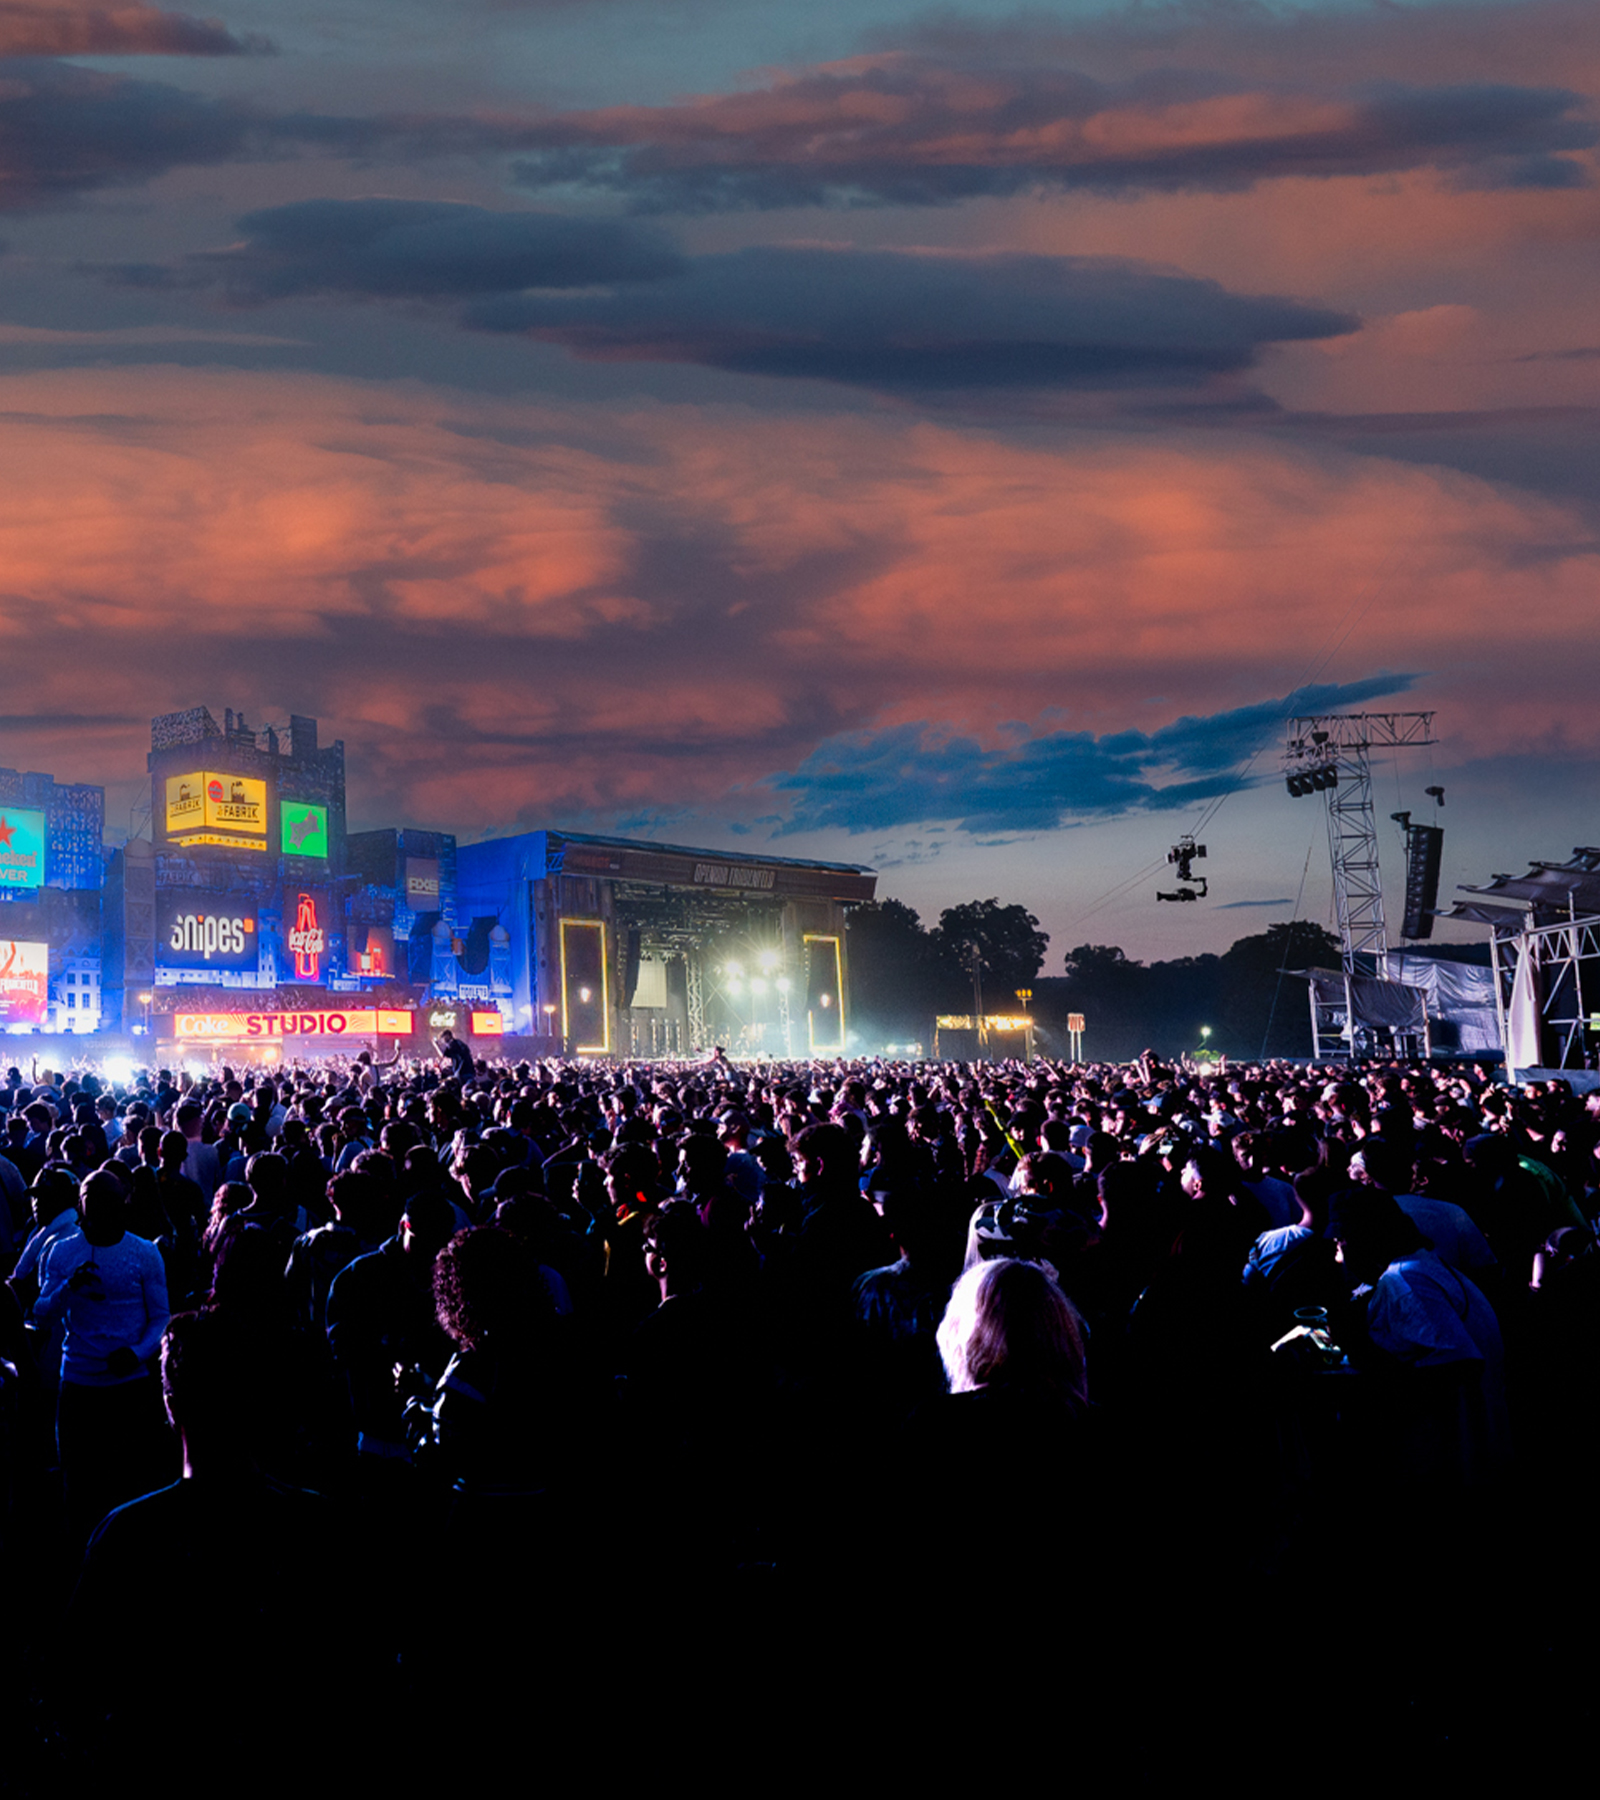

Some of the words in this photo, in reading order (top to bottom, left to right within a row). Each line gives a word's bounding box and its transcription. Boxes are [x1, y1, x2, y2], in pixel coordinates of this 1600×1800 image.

[224, 805, 258, 818] FABRIK
[408, 877, 438, 891] AXE
[170, 914, 244, 959] snipes
[180, 1016, 229, 1034] Coke
[247, 1013, 347, 1035] STUDIO
